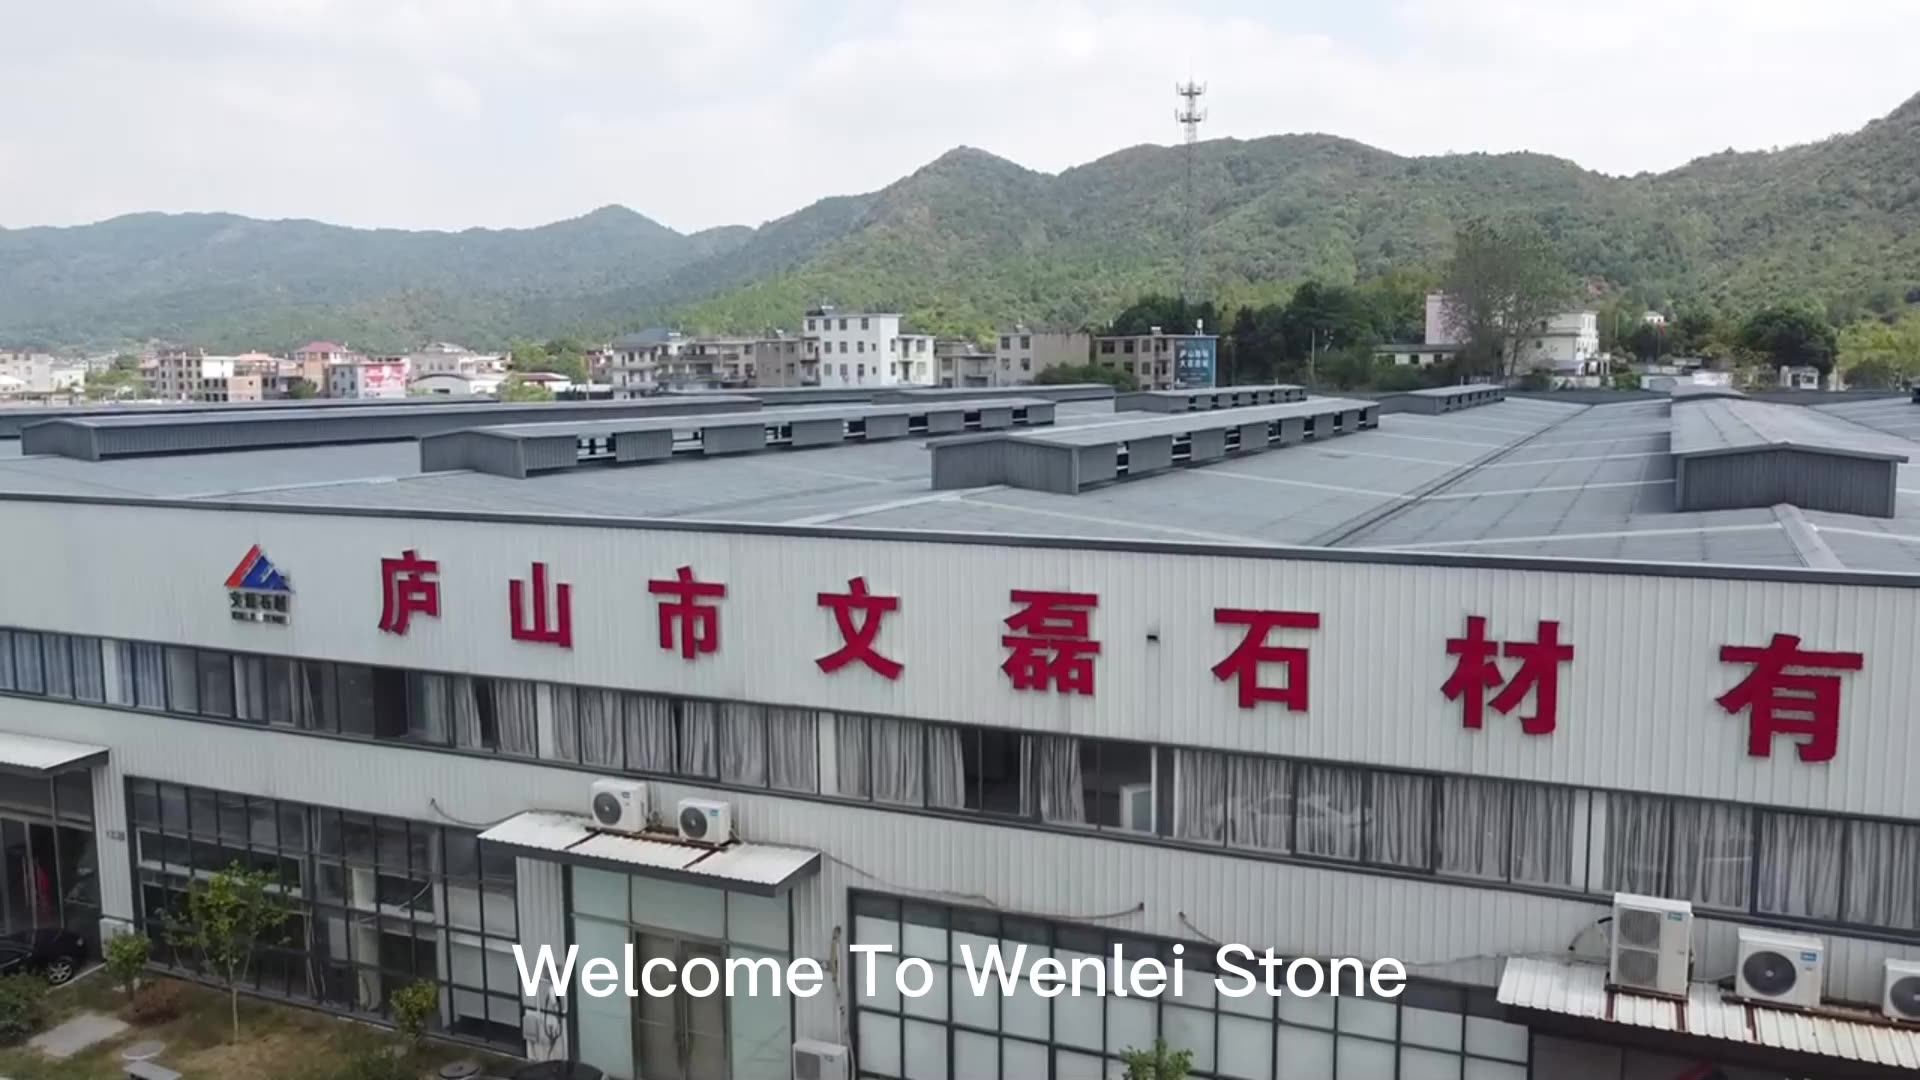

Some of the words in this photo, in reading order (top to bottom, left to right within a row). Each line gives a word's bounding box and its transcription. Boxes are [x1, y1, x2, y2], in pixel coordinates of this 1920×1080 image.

[379, 549, 1864, 763] 庐山市文磊石材有
